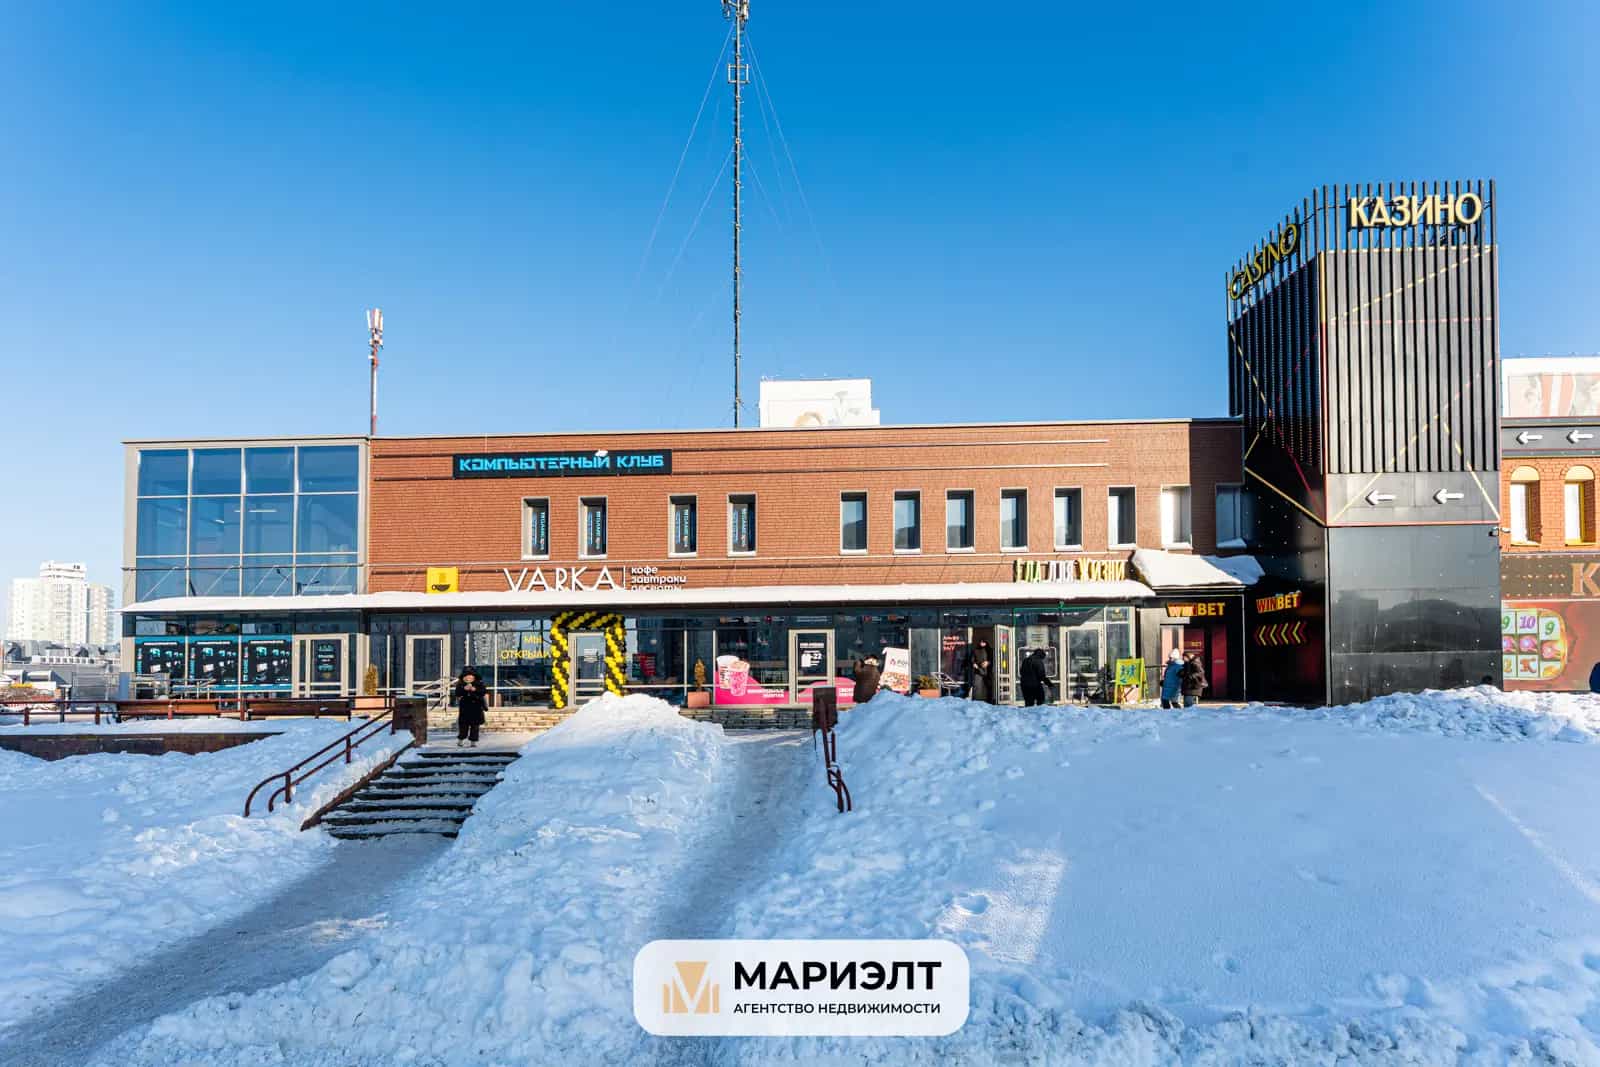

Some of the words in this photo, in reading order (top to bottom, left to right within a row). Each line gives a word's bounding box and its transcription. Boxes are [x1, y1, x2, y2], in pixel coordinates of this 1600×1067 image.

[1350, 192, 1483, 228] КАЗИНО
[1229, 223, 1298, 300] CASINO
[459, 454, 610, 472] КОМПЬЮТЕРНЫЙ
[616, 454, 665, 468] КЛУБ
[503, 565, 620, 592] VARKA
[631, 565, 658, 576] кофе
[631, 576, 687, 585] завтраки
[1167, 602, 1226, 617] WINBET
[1256, 593, 1302, 614] WINBET
[1520, 615, 1536, 629] 10
[501, 649, 552, 659] ОТКРЫЛИ
